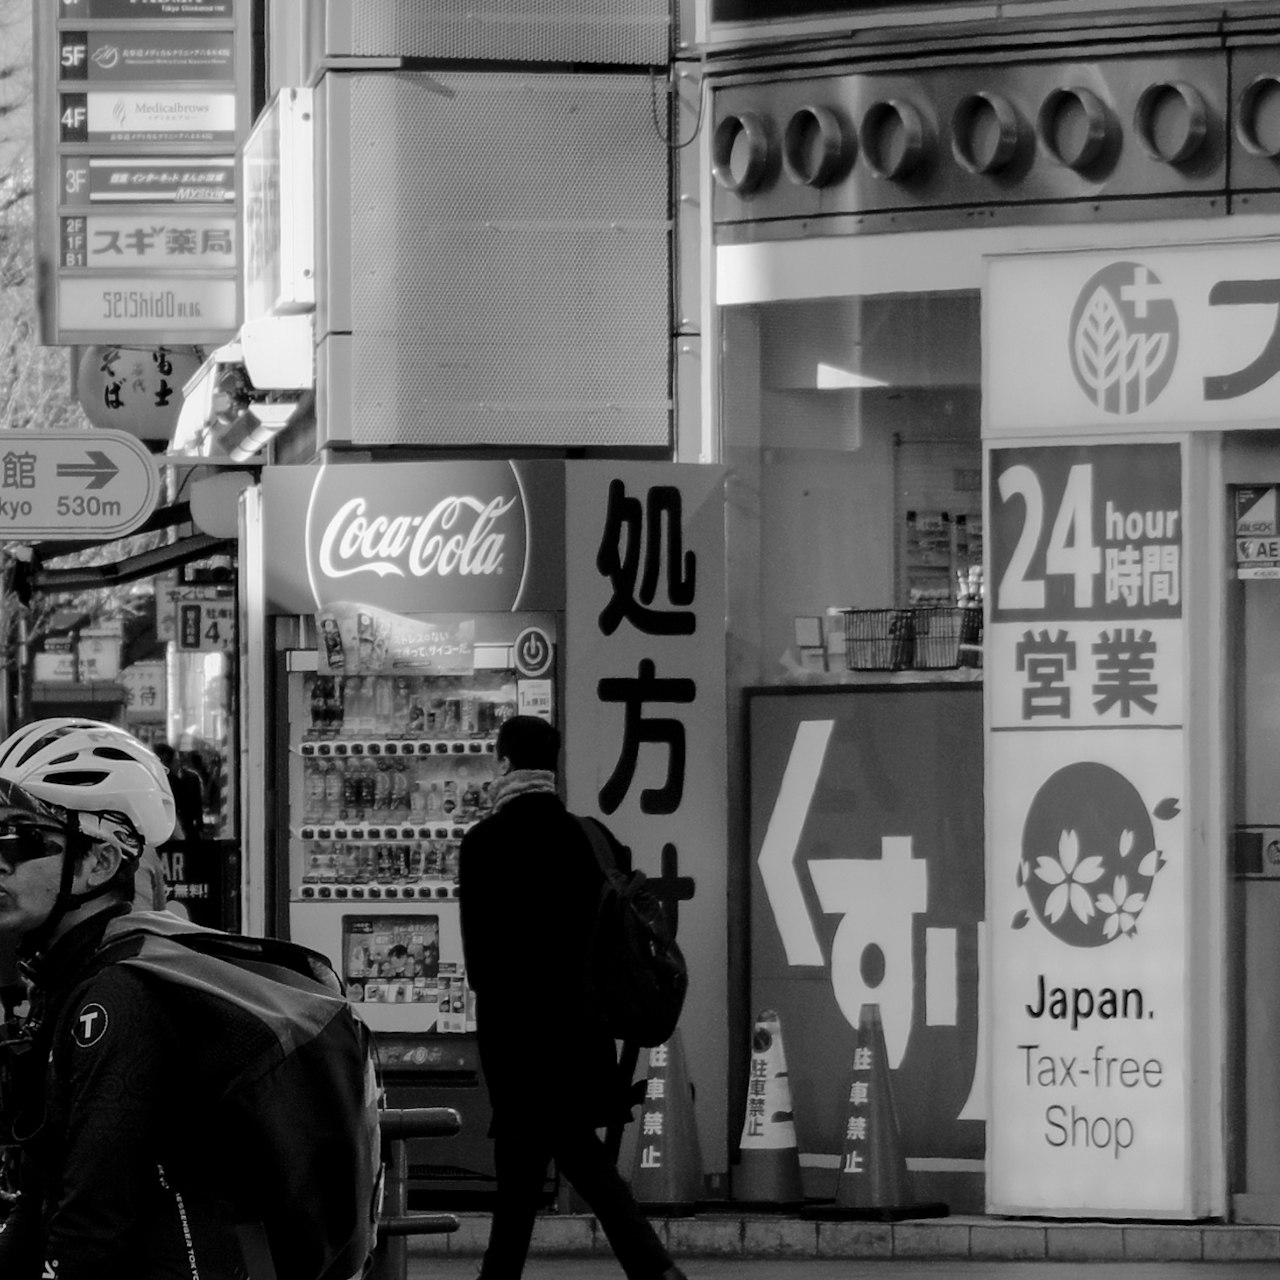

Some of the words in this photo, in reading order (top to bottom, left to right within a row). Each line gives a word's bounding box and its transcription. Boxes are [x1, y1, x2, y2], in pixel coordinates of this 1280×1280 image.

[61, 46, 85, 66] 5F
[61, 108, 86, 128] 4F
[135, 102, 209, 114] Medicalbrows
[66, 170, 86, 193] 3F
[67, 219, 82, 232] 2F
[68, 237, 82, 250] 1F
[92, 226, 232, 256] スギ薬局
[66, 253, 82, 267] B1
[100, 350, 127, 409] そば
[56, 496, 122, 516] 530m
[320, 495, 517, 578] Coca-Cola
[998, 463, 1102, 610] 24
[1105, 500, 1179, 541] hour
[1105, 544, 1180, 608] 時間
[1015, 627, 1159, 721] 営業
[1025, 974, 1154, 1031] Japan.
[1017, 1045, 1163, 1089] Tax-free
[641, 1043, 669, 1169] 駐車禁止
[746, 1059, 768, 1138] 駐車禁止
[843, 1046, 872, 1173] 駐車禁止
[1045, 1105, 1134, 1160] Shop
